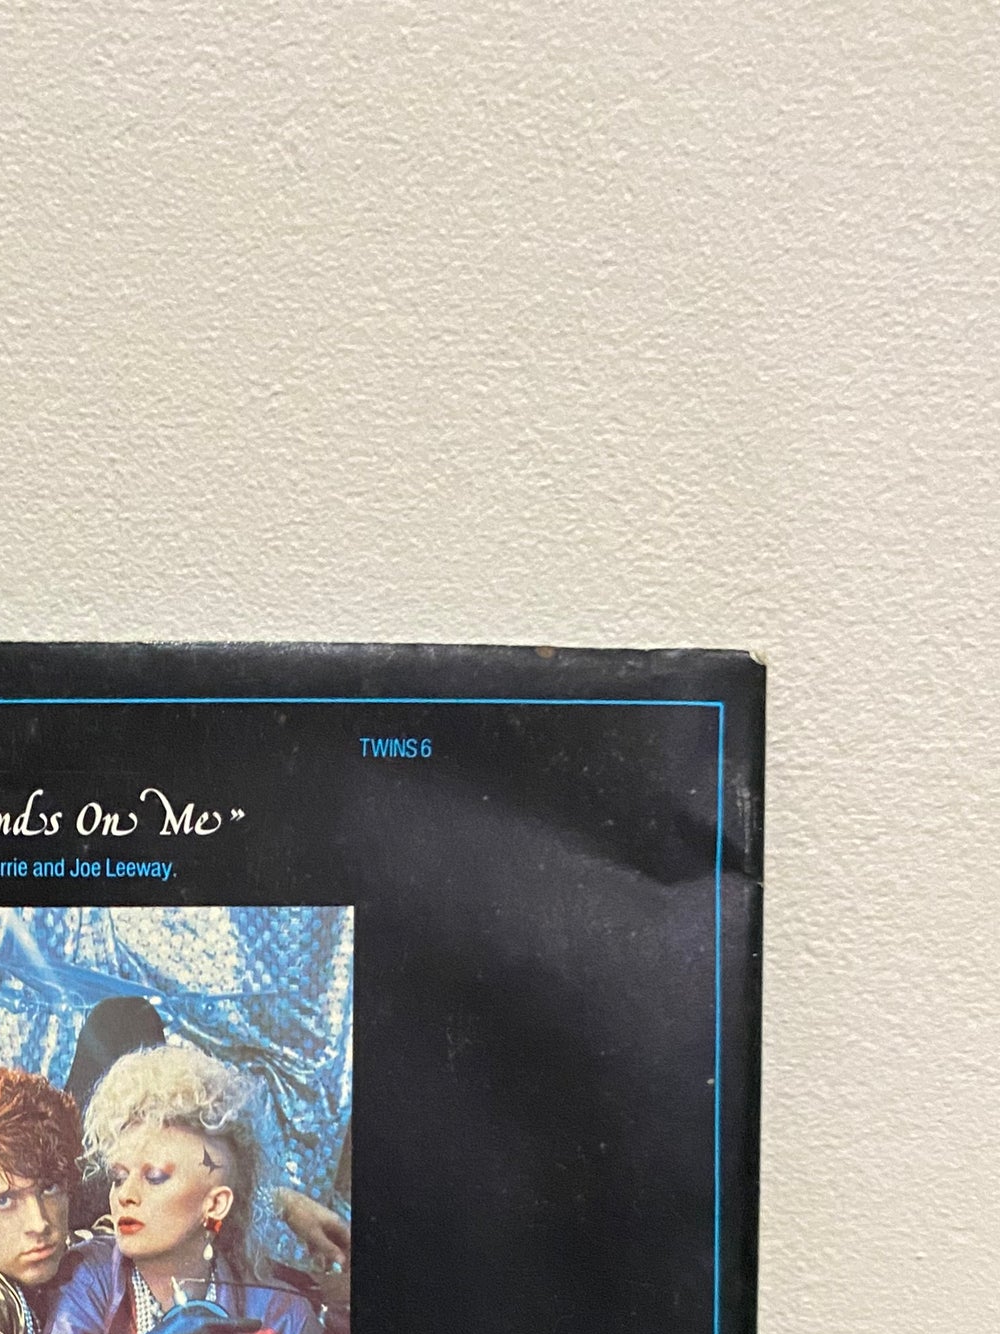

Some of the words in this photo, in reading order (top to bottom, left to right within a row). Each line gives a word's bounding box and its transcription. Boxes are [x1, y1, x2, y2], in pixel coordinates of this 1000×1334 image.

[75, 801, 139, 836] On
[32, 857, 65, 878] and
[69, 857, 102, 878] Joe
[105, 857, 178, 882] Leeway.
